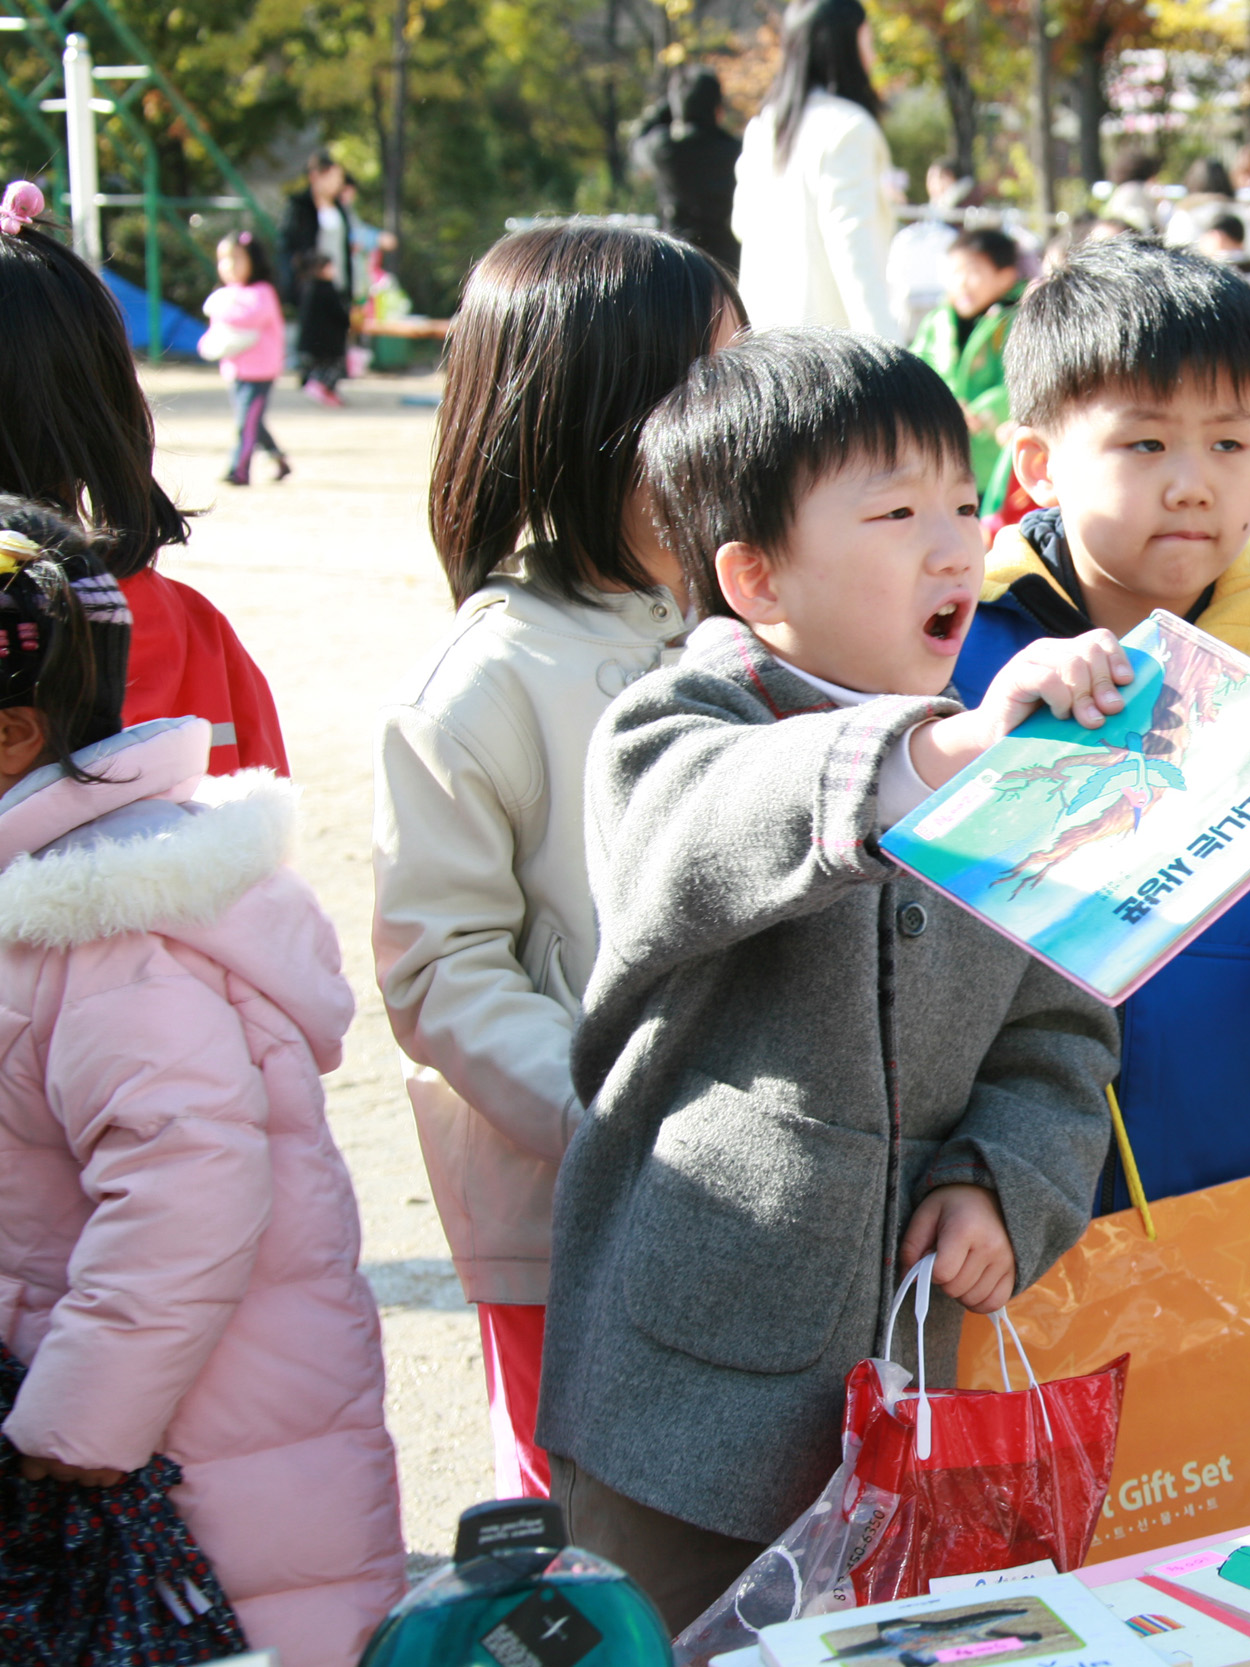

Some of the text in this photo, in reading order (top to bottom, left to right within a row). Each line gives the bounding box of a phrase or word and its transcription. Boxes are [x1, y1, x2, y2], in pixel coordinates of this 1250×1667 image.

[1112, 855, 1196, 925] 사냥꾼
[1118, 1463, 1183, 1512] Gift
[1185, 1452, 1236, 1494] Set
